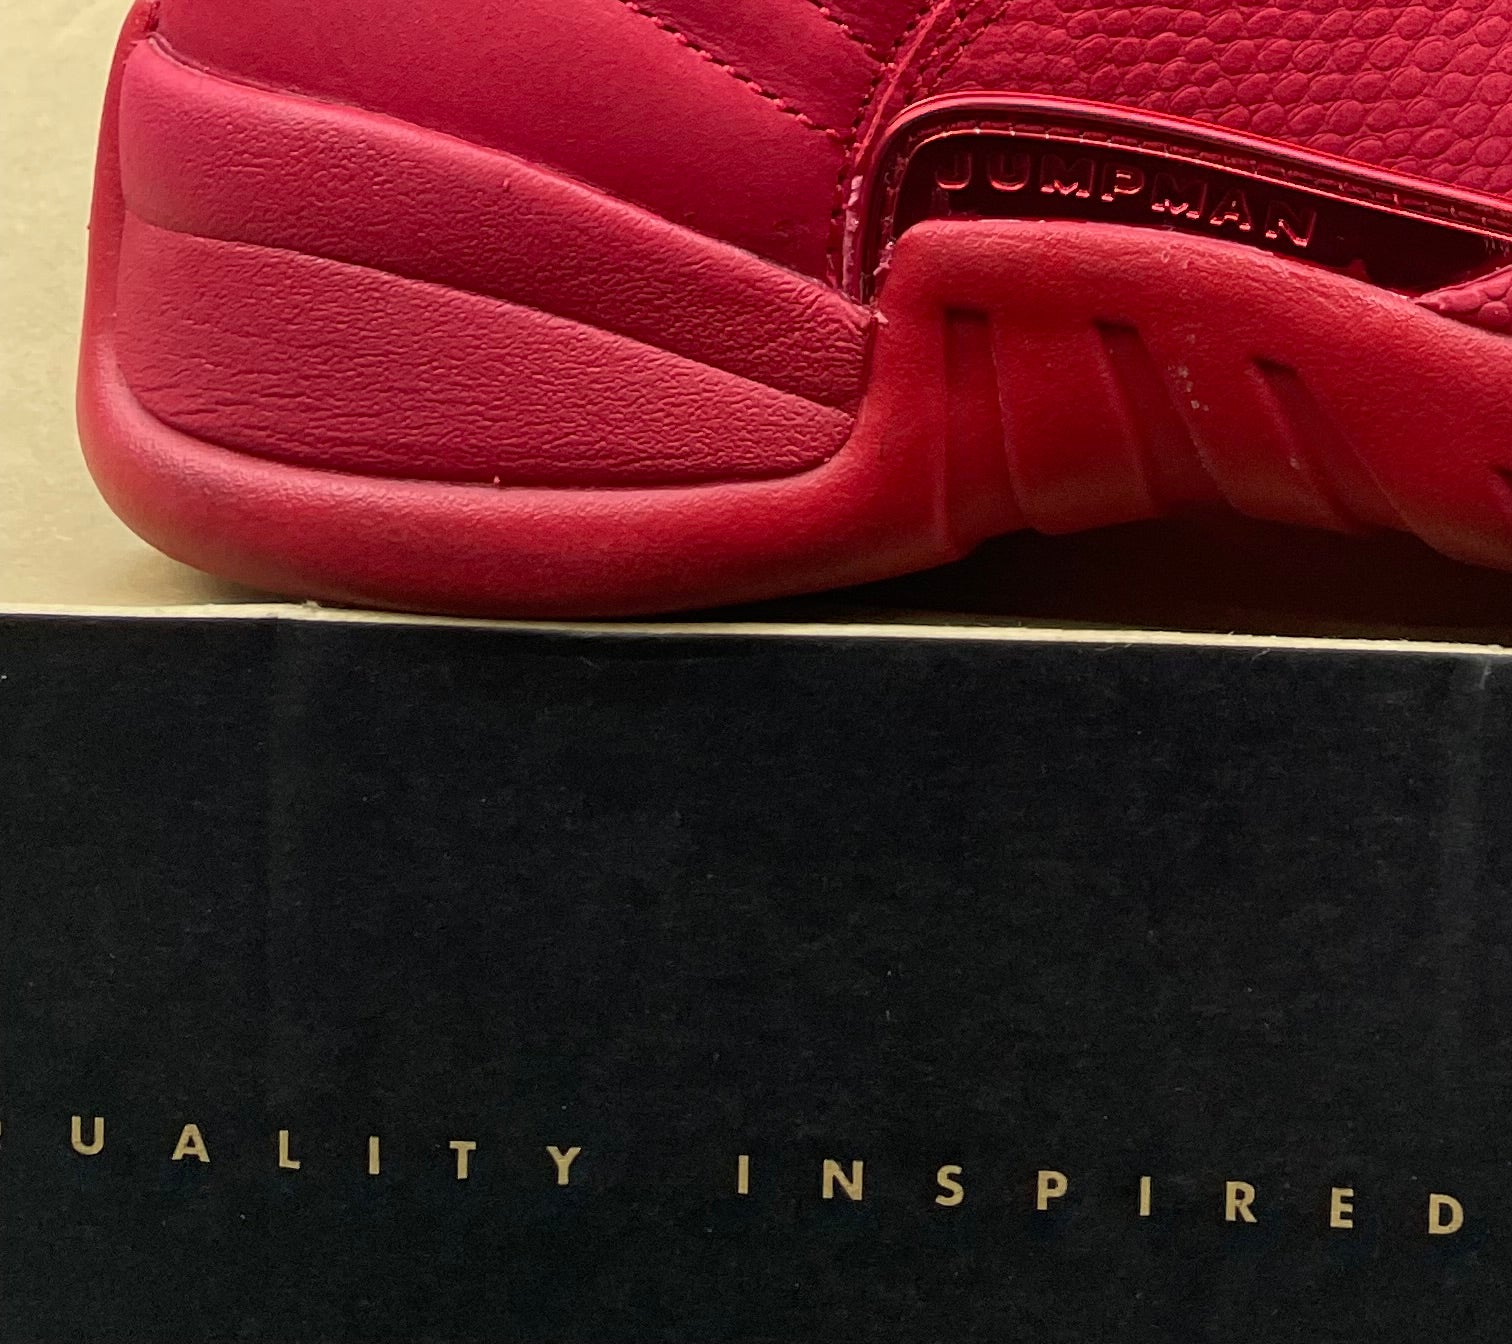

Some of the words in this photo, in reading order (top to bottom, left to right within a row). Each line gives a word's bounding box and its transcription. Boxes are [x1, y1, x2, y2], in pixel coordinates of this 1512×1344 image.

[934, 151, 1318, 248] JUMPMAN
[0, 1115, 581, 1185] UALITY
[737, 1154, 1464, 1235] INSPIRED
